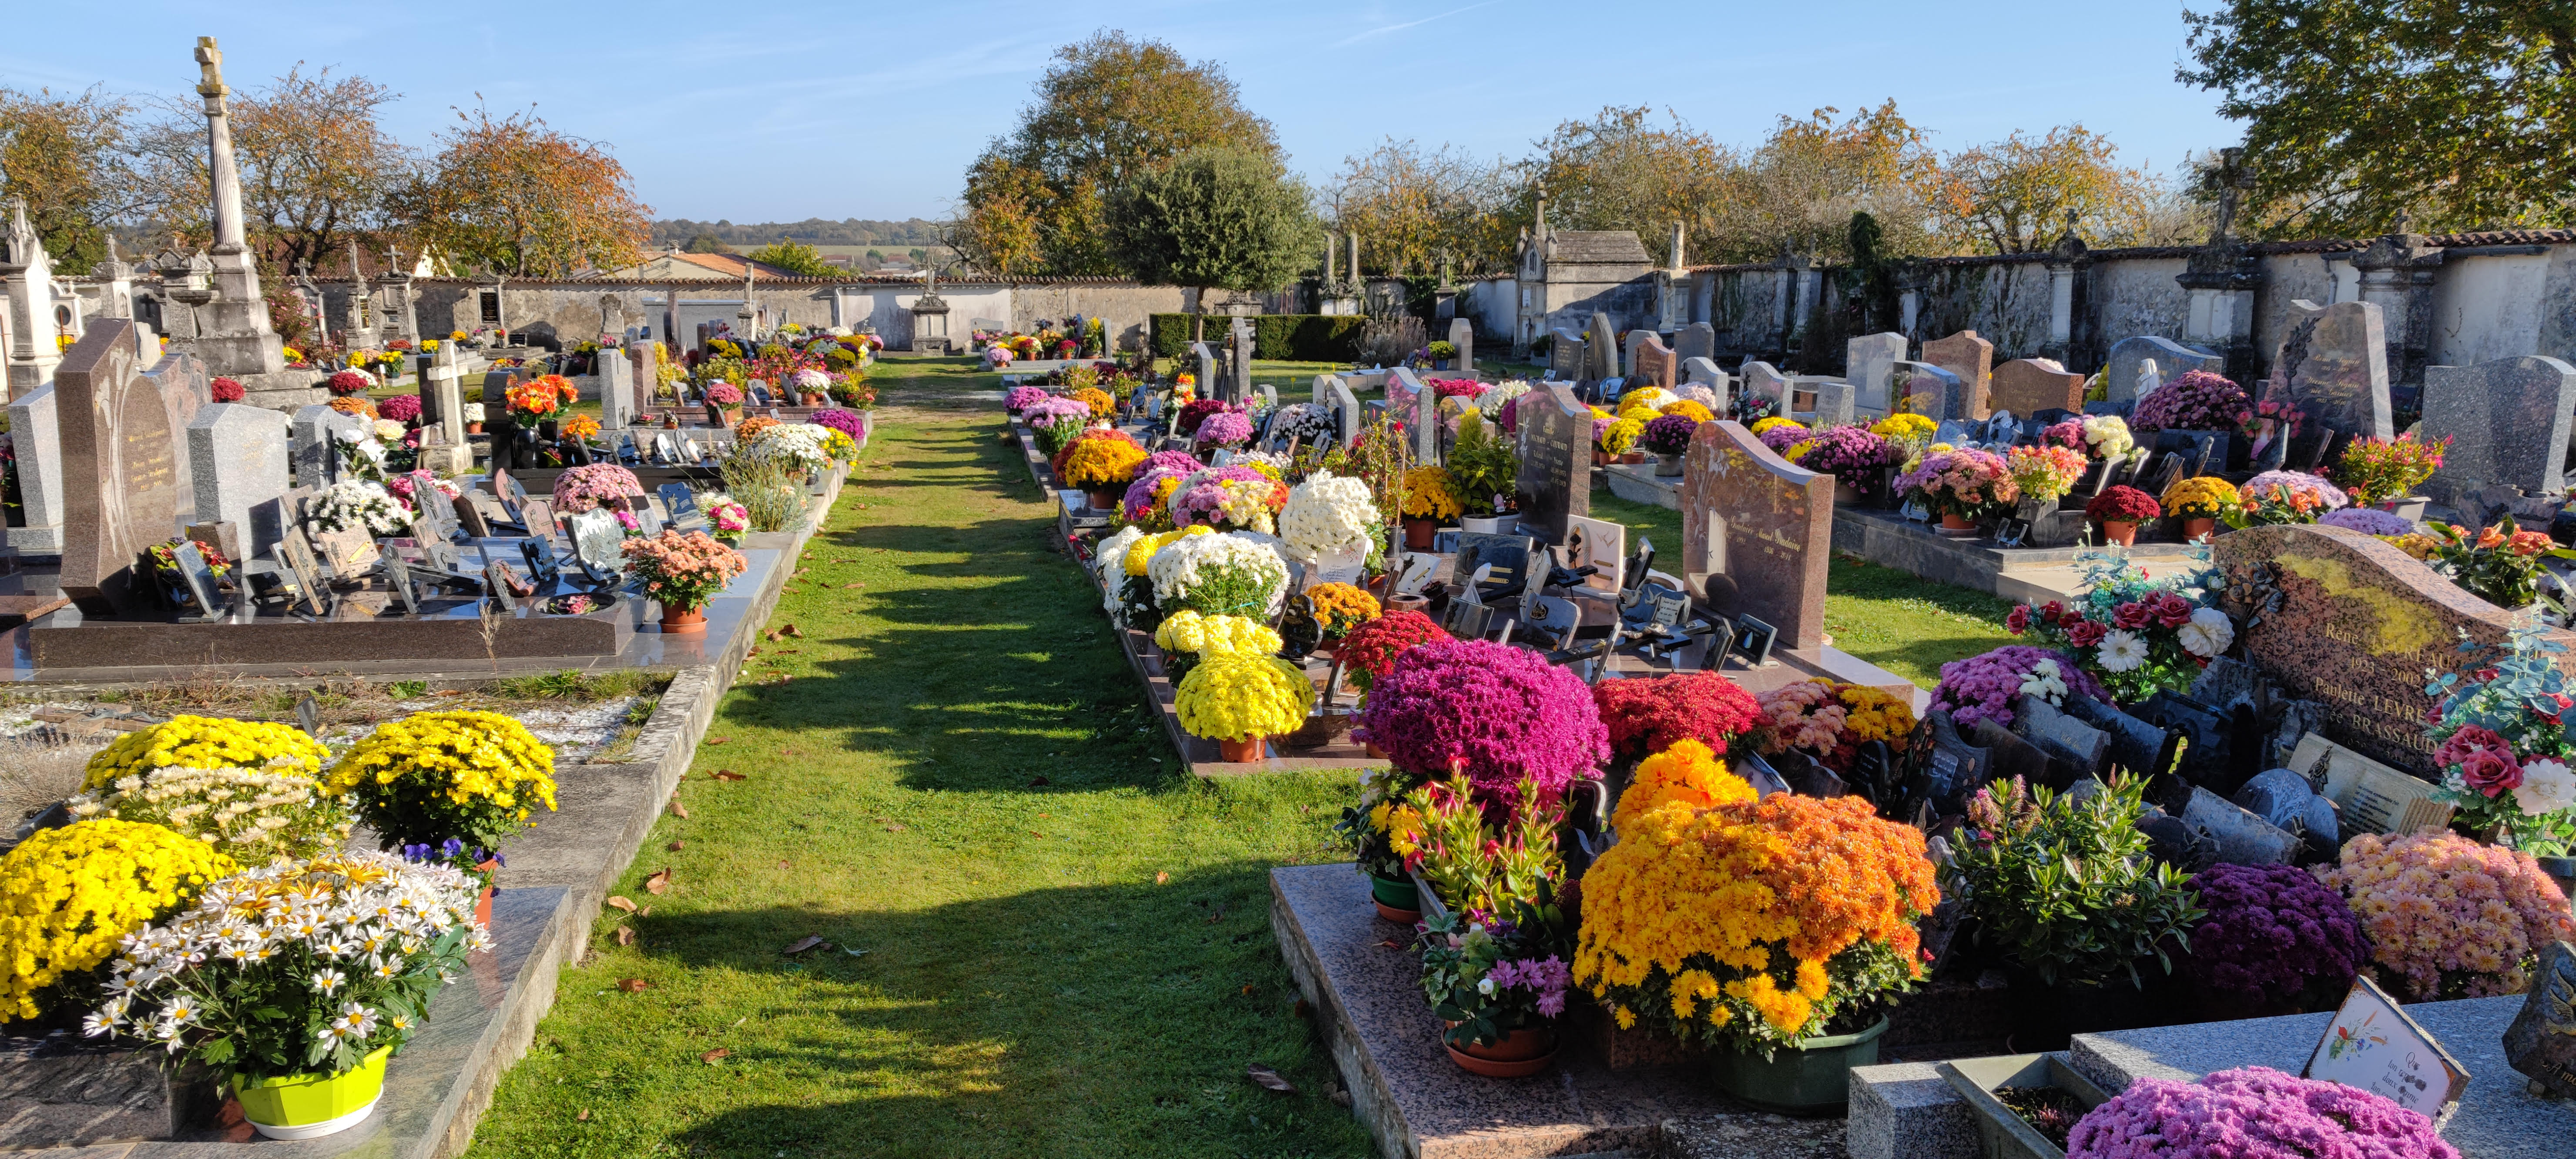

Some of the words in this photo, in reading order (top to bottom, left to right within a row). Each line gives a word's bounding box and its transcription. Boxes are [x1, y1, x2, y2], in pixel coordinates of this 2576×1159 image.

[2351, 656, 2375, 674] 1923
[2391, 668, 2421, 688] 2002
[2315, 677, 2365, 706] Paulette
[2374, 695, 2427, 724] LEVRE
[2352, 713, 2438, 755] BRASSAUD
[2382, 1072, 2398, 1089] doux
